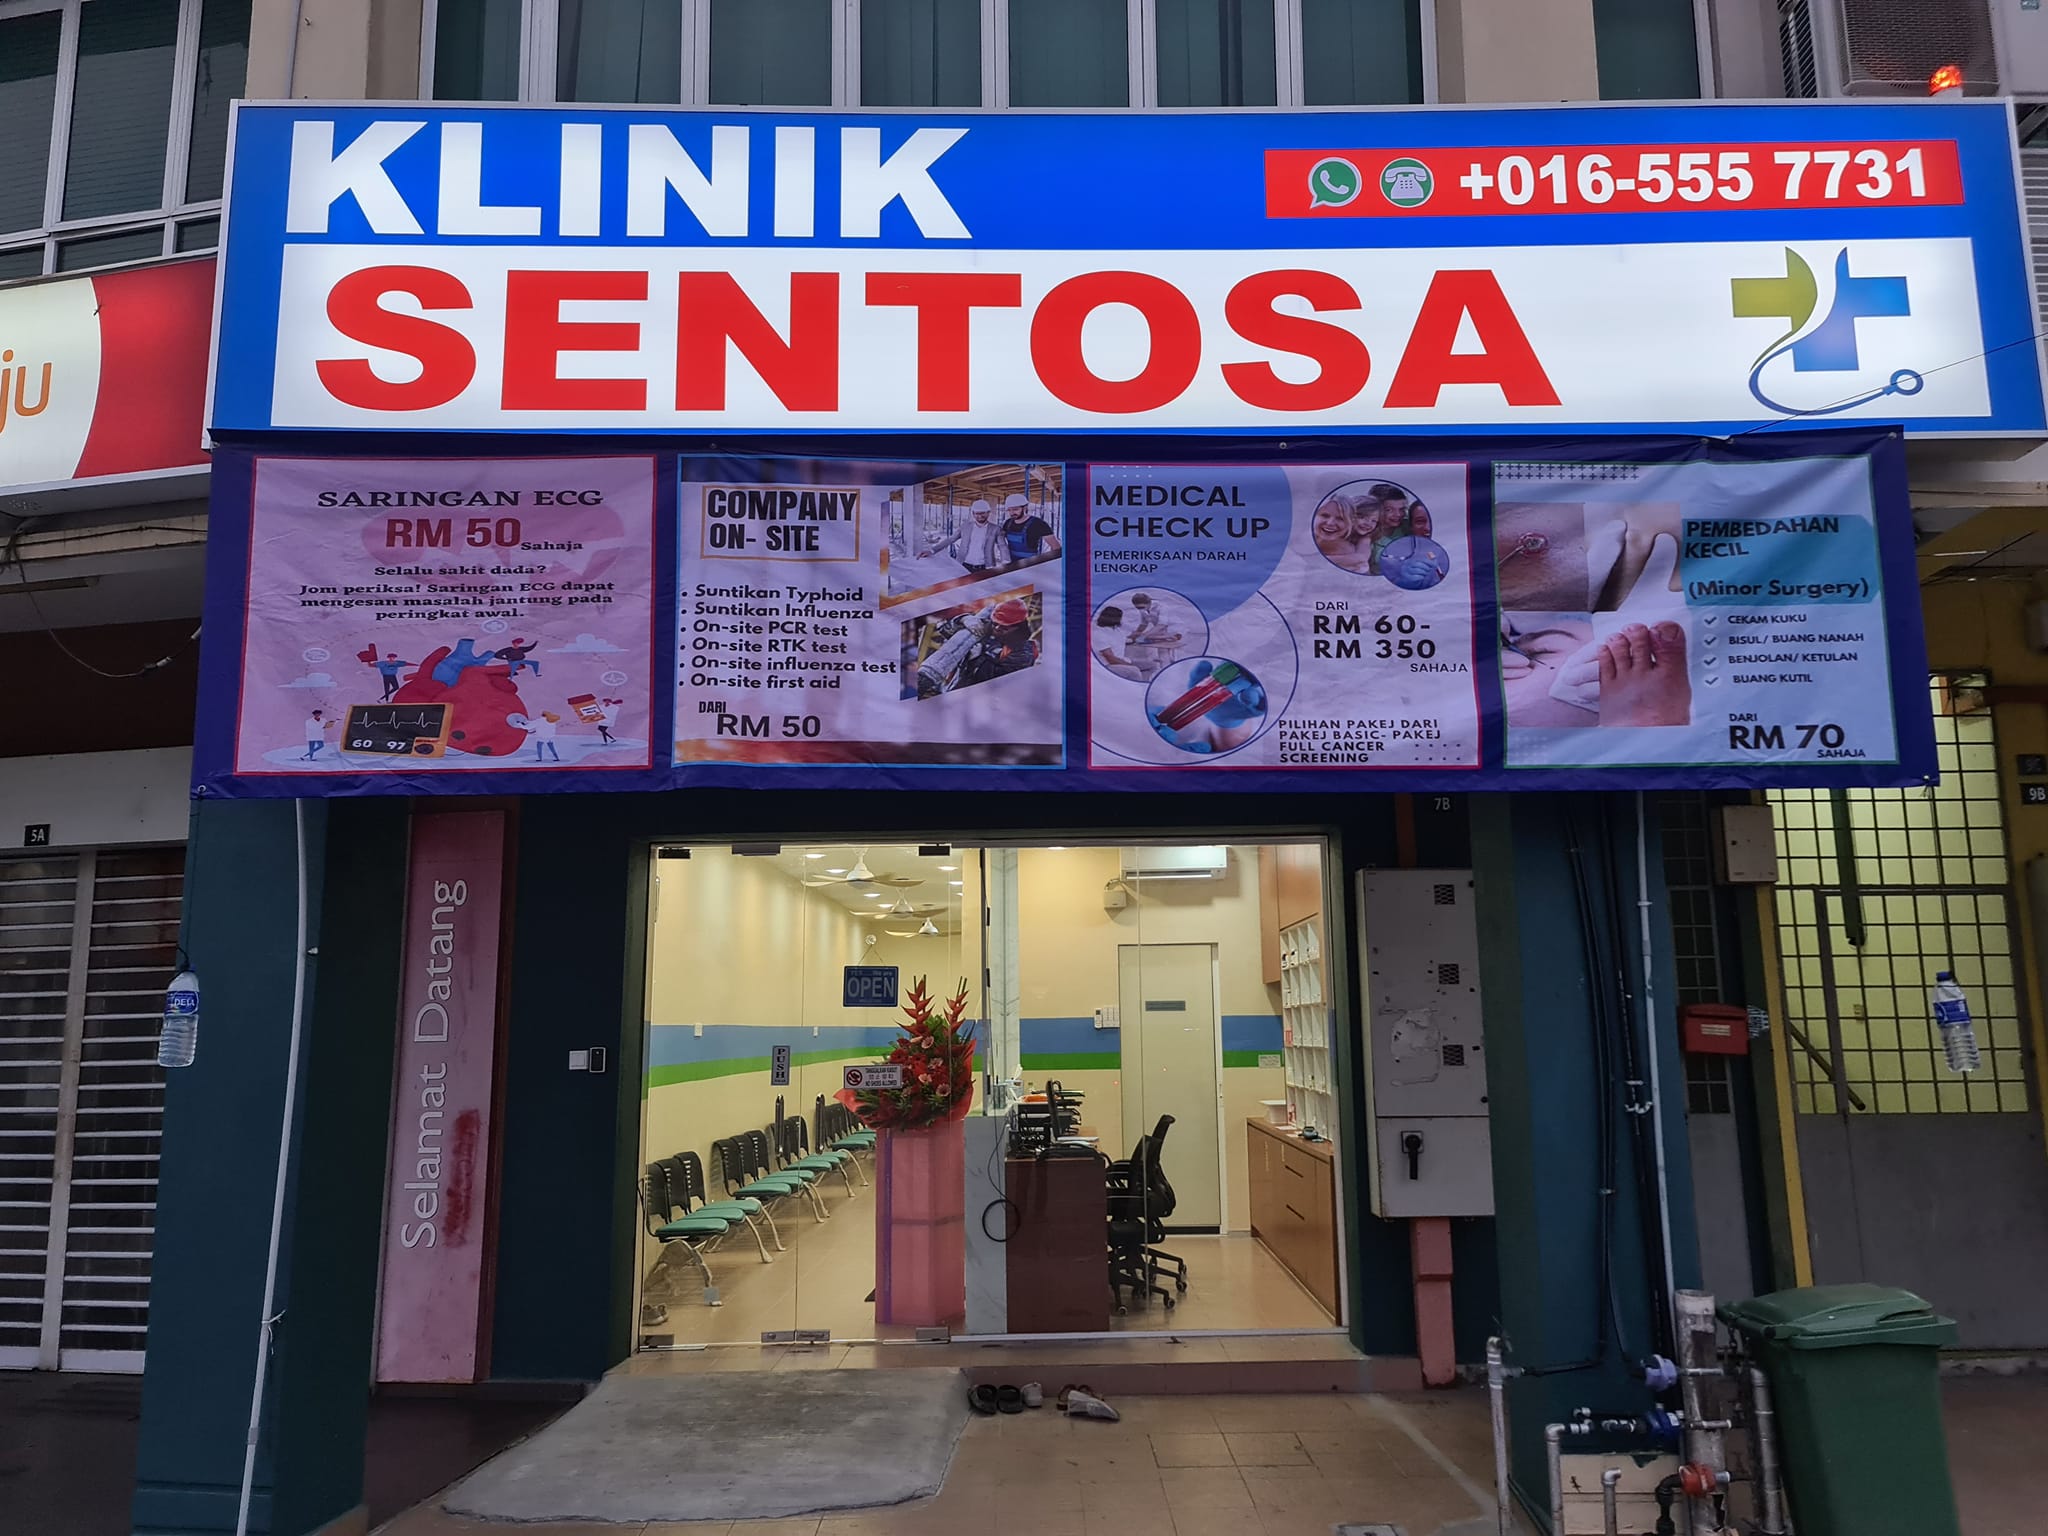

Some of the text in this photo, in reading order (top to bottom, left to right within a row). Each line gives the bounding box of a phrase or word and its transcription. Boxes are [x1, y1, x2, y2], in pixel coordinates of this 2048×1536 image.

[286, 121, 971, 241] KLINIK
[1460, 147, 1927, 206] +016-555 7731
[316, 266, 1562, 412] SENTOSA
[318, 490, 604, 508] SARINGAN ECG
[1095, 485, 1246, 507] MEDICAL
[708, 490, 858, 521] COMPANY
[386, 517, 583, 552] RM 50 Sahaja
[1095, 517, 1270, 539] CHECK UP
[1686, 517, 1839, 538] PEMBEDAHAN
[710, 523, 819, 551] ON- SITE
[1094, 550, 1247, 561] PEMERIKSAAN DARAH
[1685, 543, 1749, 559] KECIL
[374, 564, 546, 576] Selalu sakit dada?
[1094, 563, 1158, 573] LENGKAP
[300, 582, 614, 596] Jom periksa! Saringan ECG dapat
[695, 584, 863, 604] Suntikan Typhoid
[1688, 578, 1869, 600] (Minor Surgery)
[300, 594, 613, 608] mengesan masalah jantung pada
[1316, 601, 1349, 611] DARI
[376, 608, 525, 621] peringkat awal.
[694, 602, 874, 620] Suntikan Influenza
[1728, 614, 1807, 624] CEKAM KUKU
[693, 619, 848, 637] On-site PCR test
[1313, 615, 1431, 634] RM 60-
[692, 637, 847, 654] On-site RTK test
[1728, 633, 1864, 645] BISUL/ BUANG NANAH
[1313, 639, 1436, 659] RM 350
[691, 655, 896, 674] On-site influenza test
[1728, 652, 1858, 664] BENJOLAN/ KETULAN
[1410, 663, 1468, 673] SAHAJA
[691, 673, 840, 689] On-site first aid
[1733, 673, 1813, 683] BUANG KUTIL
[699, 701, 726, 713] DARI
[717, 714, 821, 737] RM 50
[1279, 719, 1437, 729] PILIHAN PAKEJ DARI
[1729, 713, 1758, 722] DARI
[1279, 729, 1441, 740] PAKEJ BASIC- PAKEJ
[1729, 724, 1845, 749] RM 70
[352, 739, 406, 751] 60 97
[1279, 741, 1385, 751] FULL CANCER
[1279, 753, 1369, 763] SCREENING
[1817, 749, 1866, 758] SAHAJA
[2029, 787, 2046, 801] 9B
[1434, 797, 1450, 810] 7B
[30, 828, 45, 843] 5A
[846, 976, 896, 999] OPEN
[400, 879, 468, 1249] Selamat Datang
[775, 1048, 785, 1079] PUSH
